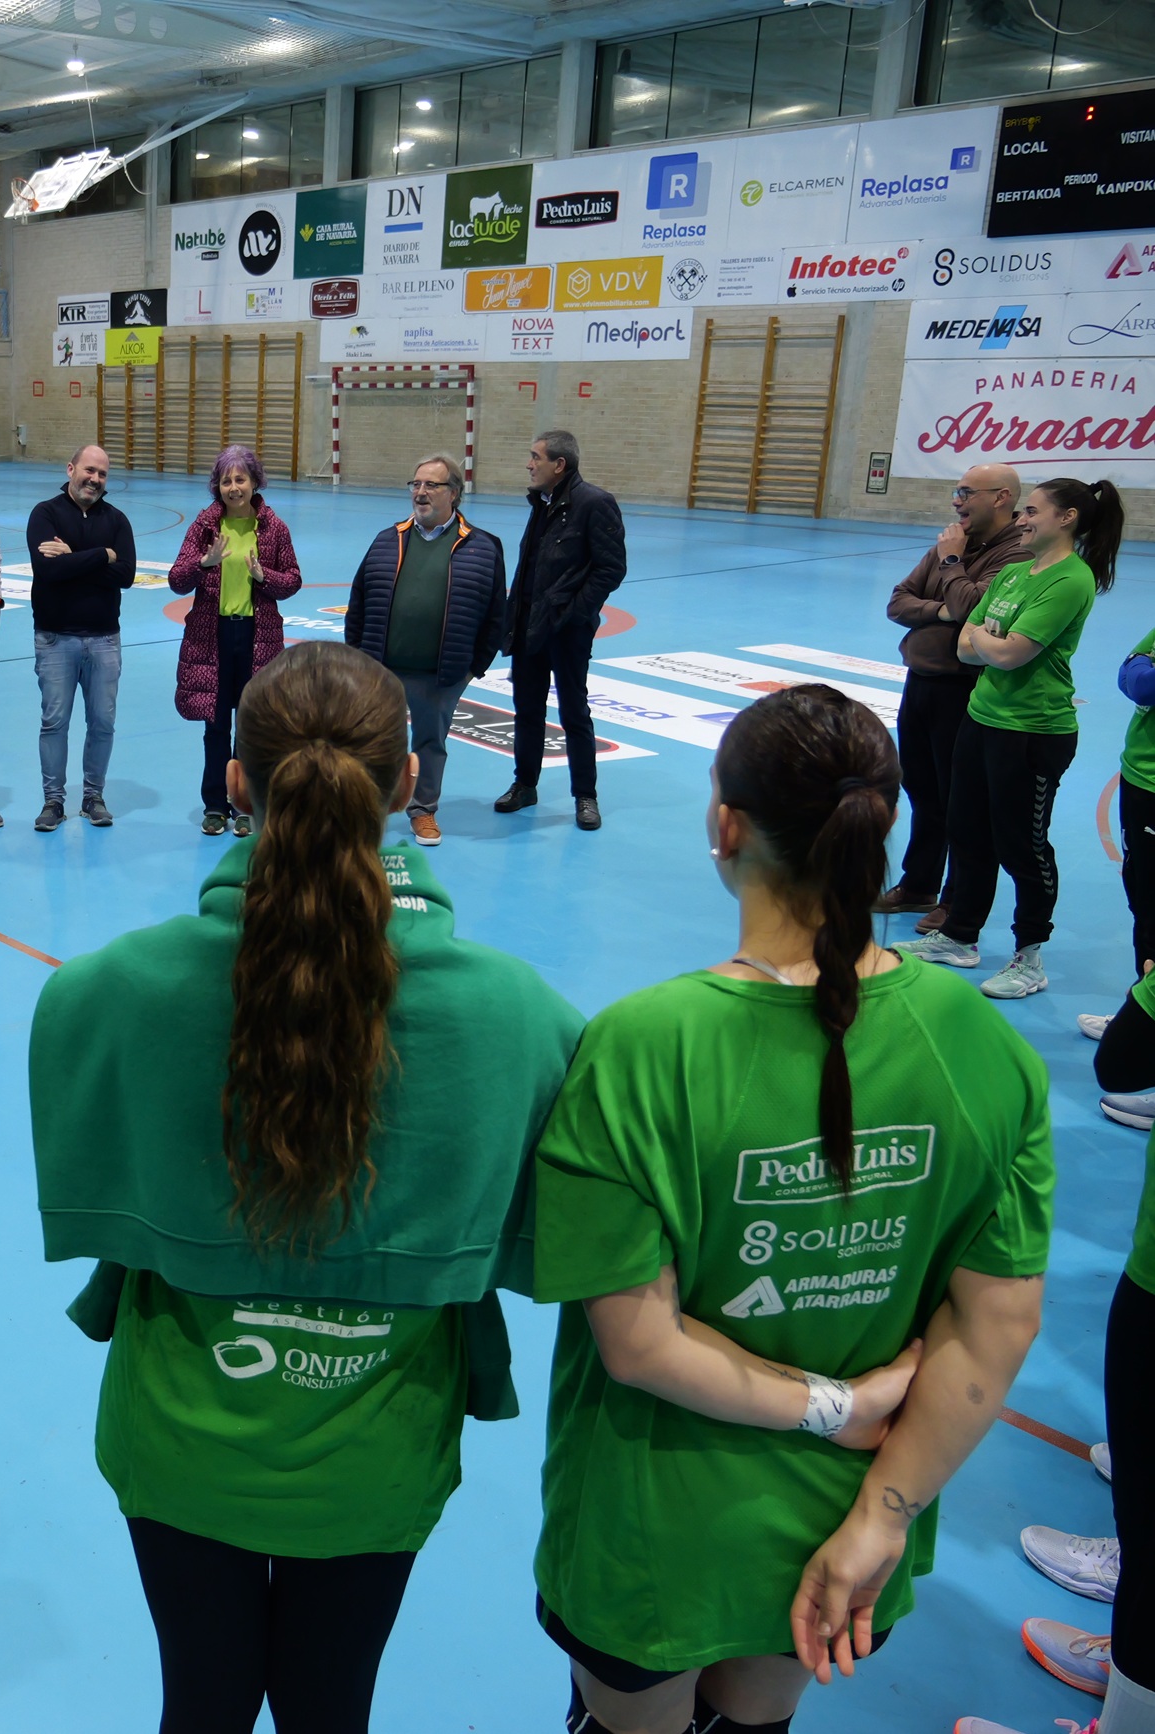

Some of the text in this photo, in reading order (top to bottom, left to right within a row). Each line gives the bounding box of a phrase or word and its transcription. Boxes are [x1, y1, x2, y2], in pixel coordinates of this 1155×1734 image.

[1003, 141, 1048, 156] LOCAL
[960, 154, 971, 166] R
[668, 173, 689, 199] R
[769, 176, 845, 193] ELCARMEN
[860, 174, 949, 198] Replasa
[1064, 173, 1098, 185] PERIODO
[996, 188, 1062, 203] BERTAKOA
[1096, 180, 1155, 195] KANPOK
[386, 185, 425, 218] DN
[542, 197, 612, 219] Pedro Luis
[859, 193, 947, 209] Advanced Materials
[503, 204, 524, 215] leche
[332, 222, 355, 231] RURAL
[449, 215, 521, 239] lacturale
[642, 223, 707, 242] Replasa
[315, 230, 357, 242] DE NAVARRA
[448, 239, 470, 248] esnea
[642, 239, 705, 249] Advanced Materials
[383, 242, 420, 253] DIARIO DE
[382, 254, 420, 266] NAVARRA
[788, 254, 897, 279] Infotec
[958, 252, 1052, 275] SOLIDUS
[599, 270, 648, 292] VDV
[999, 272, 1050, 283] SOLUTIONS
[382, 279, 455, 294] BAR EL PLENO
[801, 284, 889, 295] Servicio Técnico Autorizado
[562, 299, 649, 309] www.vdvinmobiliaria.com
[60, 306, 87, 322] KTR
[512, 318, 554, 331] NOVA
[925, 317, 1042, 340] MEDENASA
[404, 327, 434, 339] naplisa
[587, 318, 686, 348] Mediport
[120, 343, 145, 355] ALKOR
[512, 337, 553, 350] TEXT
[975, 370, 1136, 395] PANADERIA
[637, 660, 731, 683] Gobernua
[648, 656, 754, 681] Nafarroako
[756, 1137, 917, 1187] Pedr Luis
[775, 1183, 828, 1197] CONSERVA
[780, 1216, 907, 1252] SOLIDUS
[837, 1238, 902, 1259] SOLUTIONS
[784, 1265, 898, 1294] ARMADURAS
[792, 1286, 891, 1311] ATARRABIA
[284, 1348, 391, 1378] ONIRIA
[282, 1370, 365, 1390] CONSULTING
